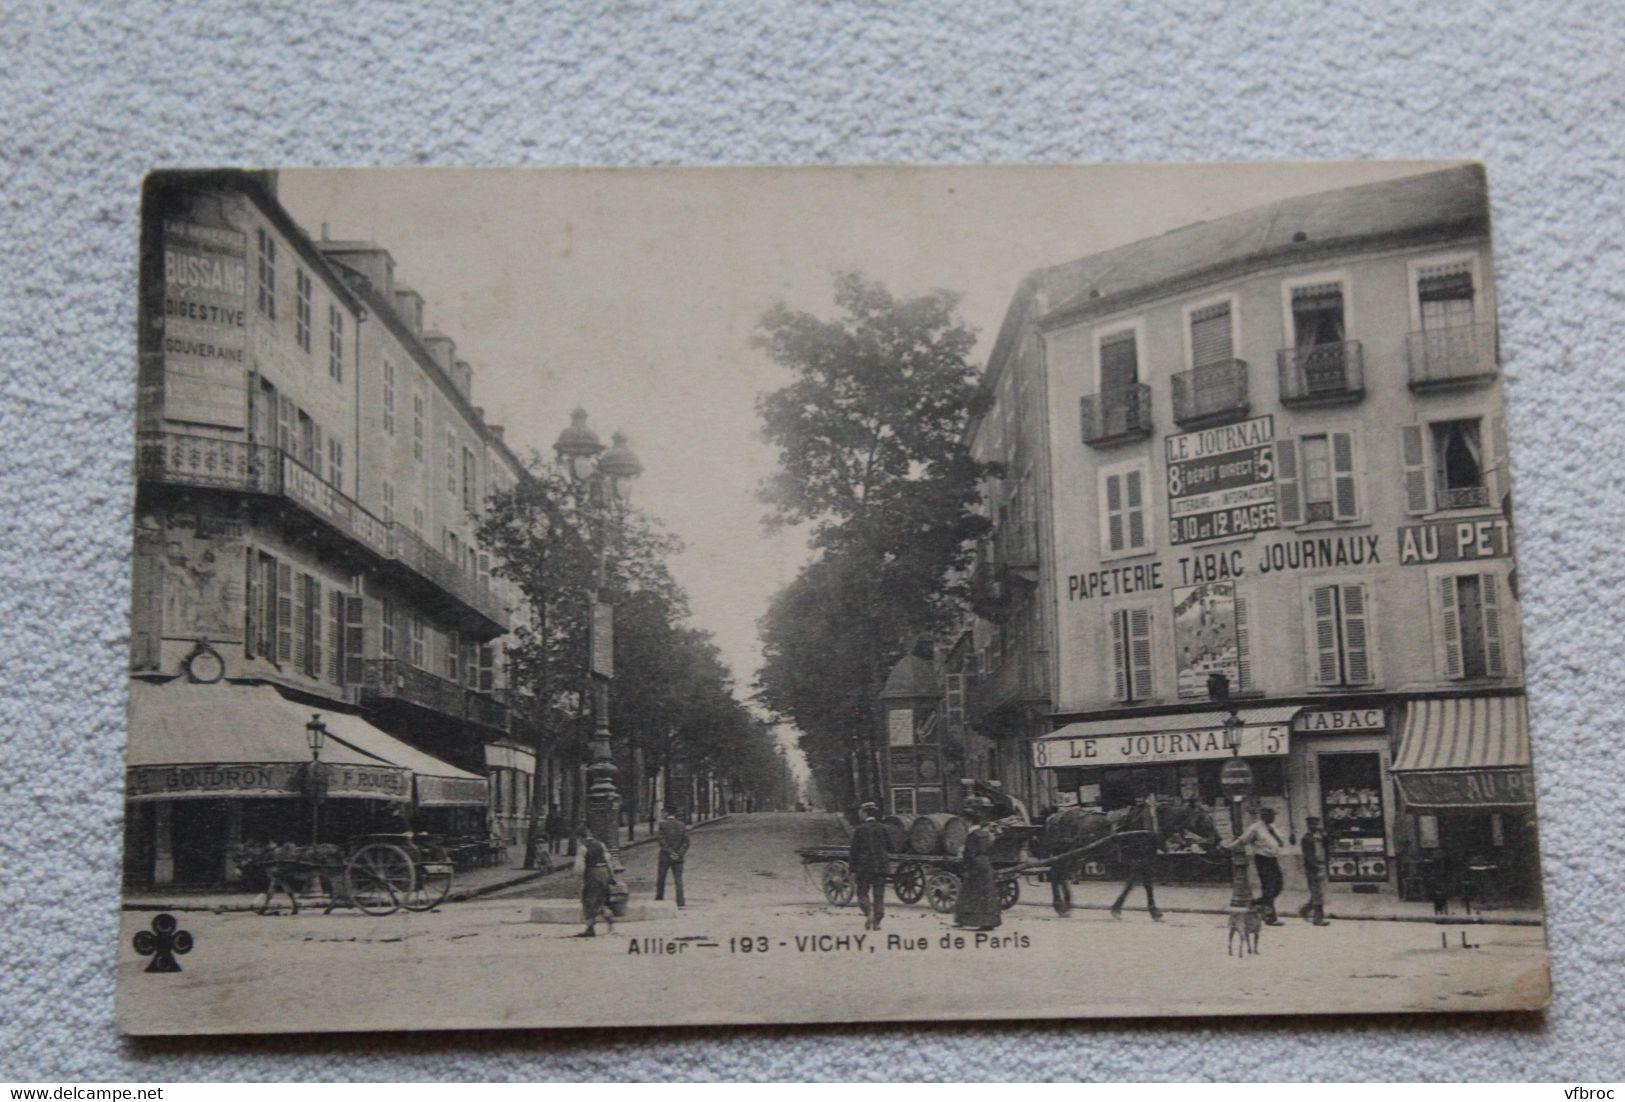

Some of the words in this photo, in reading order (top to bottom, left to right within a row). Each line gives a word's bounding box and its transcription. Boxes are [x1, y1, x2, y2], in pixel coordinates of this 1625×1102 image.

[164, 250, 245, 296] BUSSANG
[166, 299, 244, 327] DIGESTIVE
[1167, 437, 1189, 460] LE
[1195, 420, 1272, 456] JOURNAL
[1260, 448, 1272, 479] 5
[1213, 512, 1229, 536] 12
[1232, 504, 1277, 532] PAGES
[1068, 562, 1164, 601] PAPETERIE
[1179, 549, 1245, 585] TABAC
[1259, 534, 1381, 574] JOURNAUX
[1402, 525, 1440, 564] AU
[1302, 710, 1379, 731] TABAC
[1037, 742, 1048, 766] 8
[1069, 739, 1098, 759] LE
[627, 938, 689, 955] Allier
[729, 936, 770, 953] 193
[795, 934, 875, 953] VICHY,
[887, 934, 928, 950] Rue
[939, 933, 965, 950] de
[975, 932, 1031, 949] Paris
